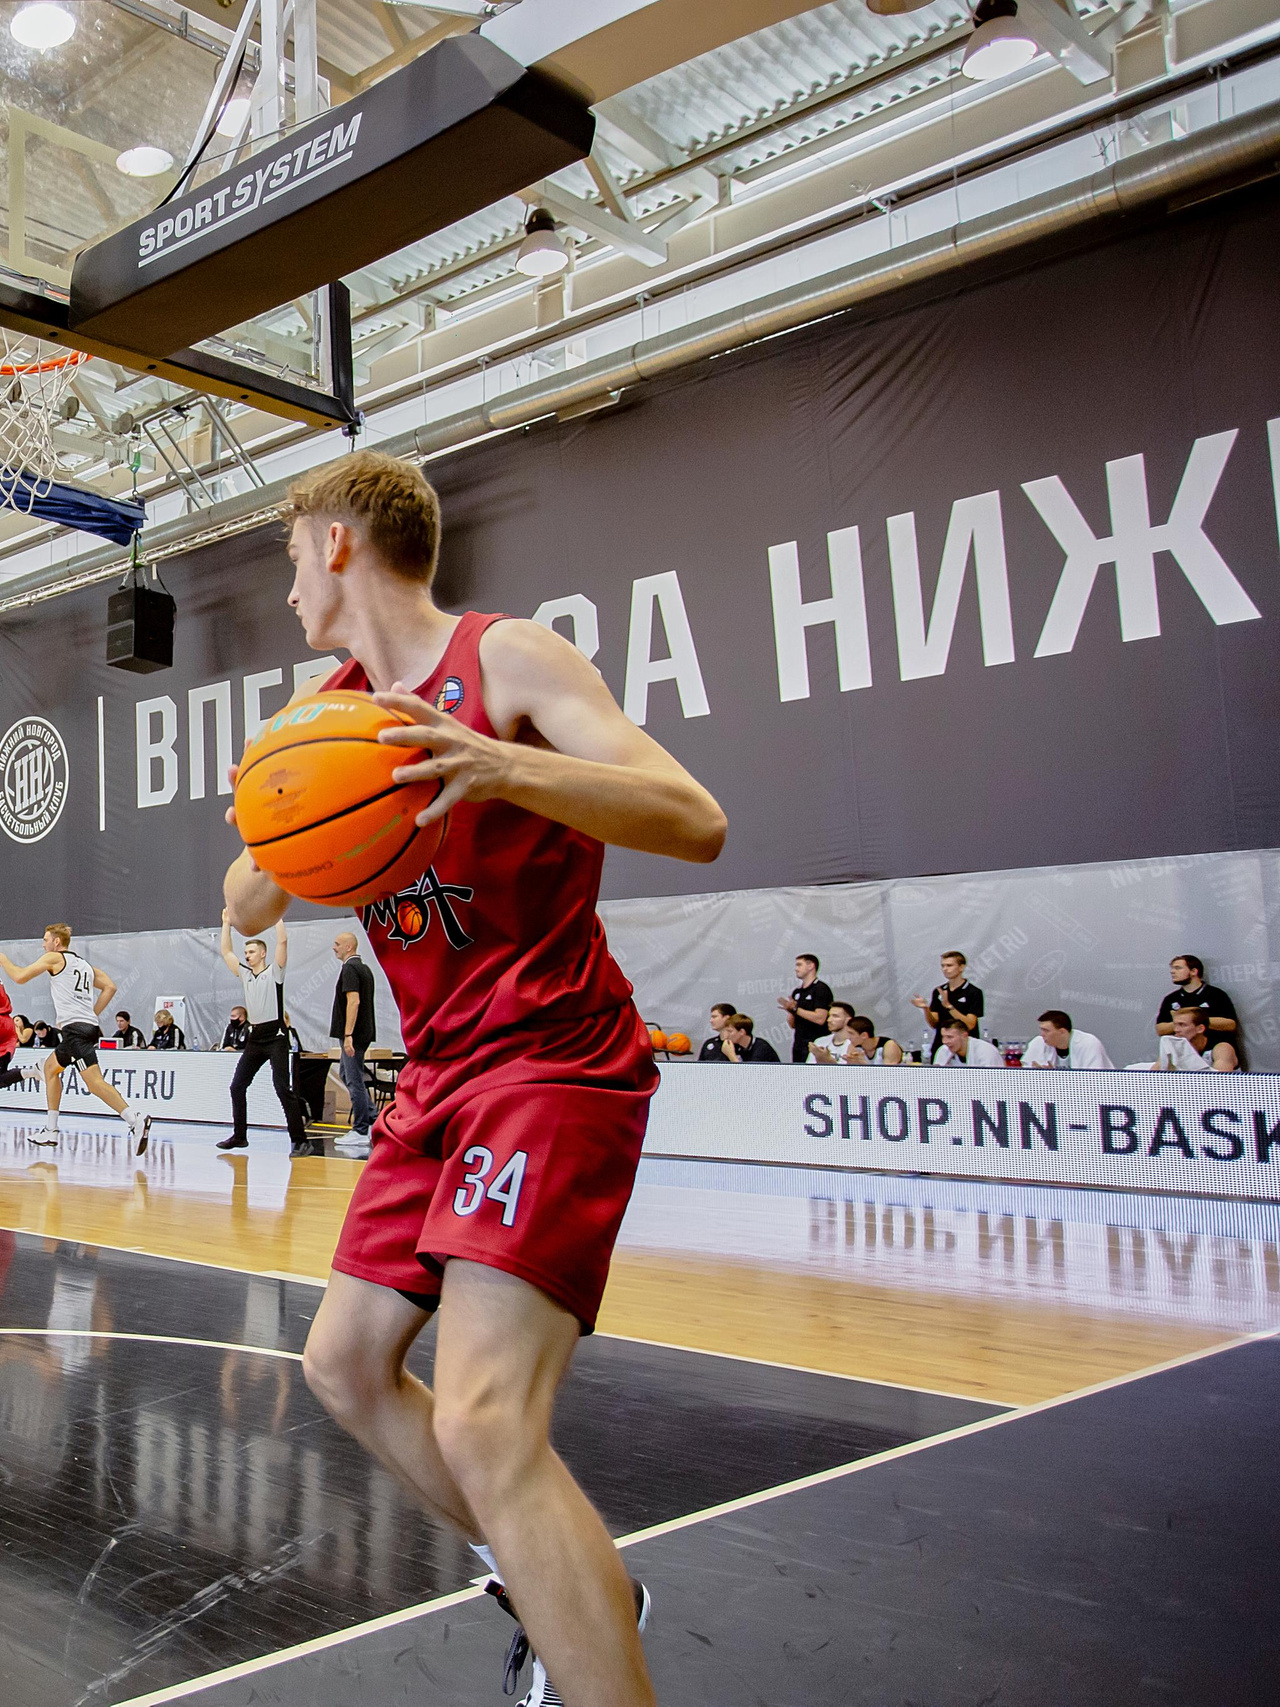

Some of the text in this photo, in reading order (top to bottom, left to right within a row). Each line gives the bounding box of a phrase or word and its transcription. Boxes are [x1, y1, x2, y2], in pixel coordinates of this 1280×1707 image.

[138, 111, 363, 257] SPORT SYSTEM
[136, 655, 343, 809] ВПЕ
[767, 416, 1280, 703] НИЖ
[26, 724, 62, 762] НОВГОРОД
[48, 780, 64, 814] КЛУБ
[73, 969, 90, 994] 24
[452, 1144, 529, 1228] 34
